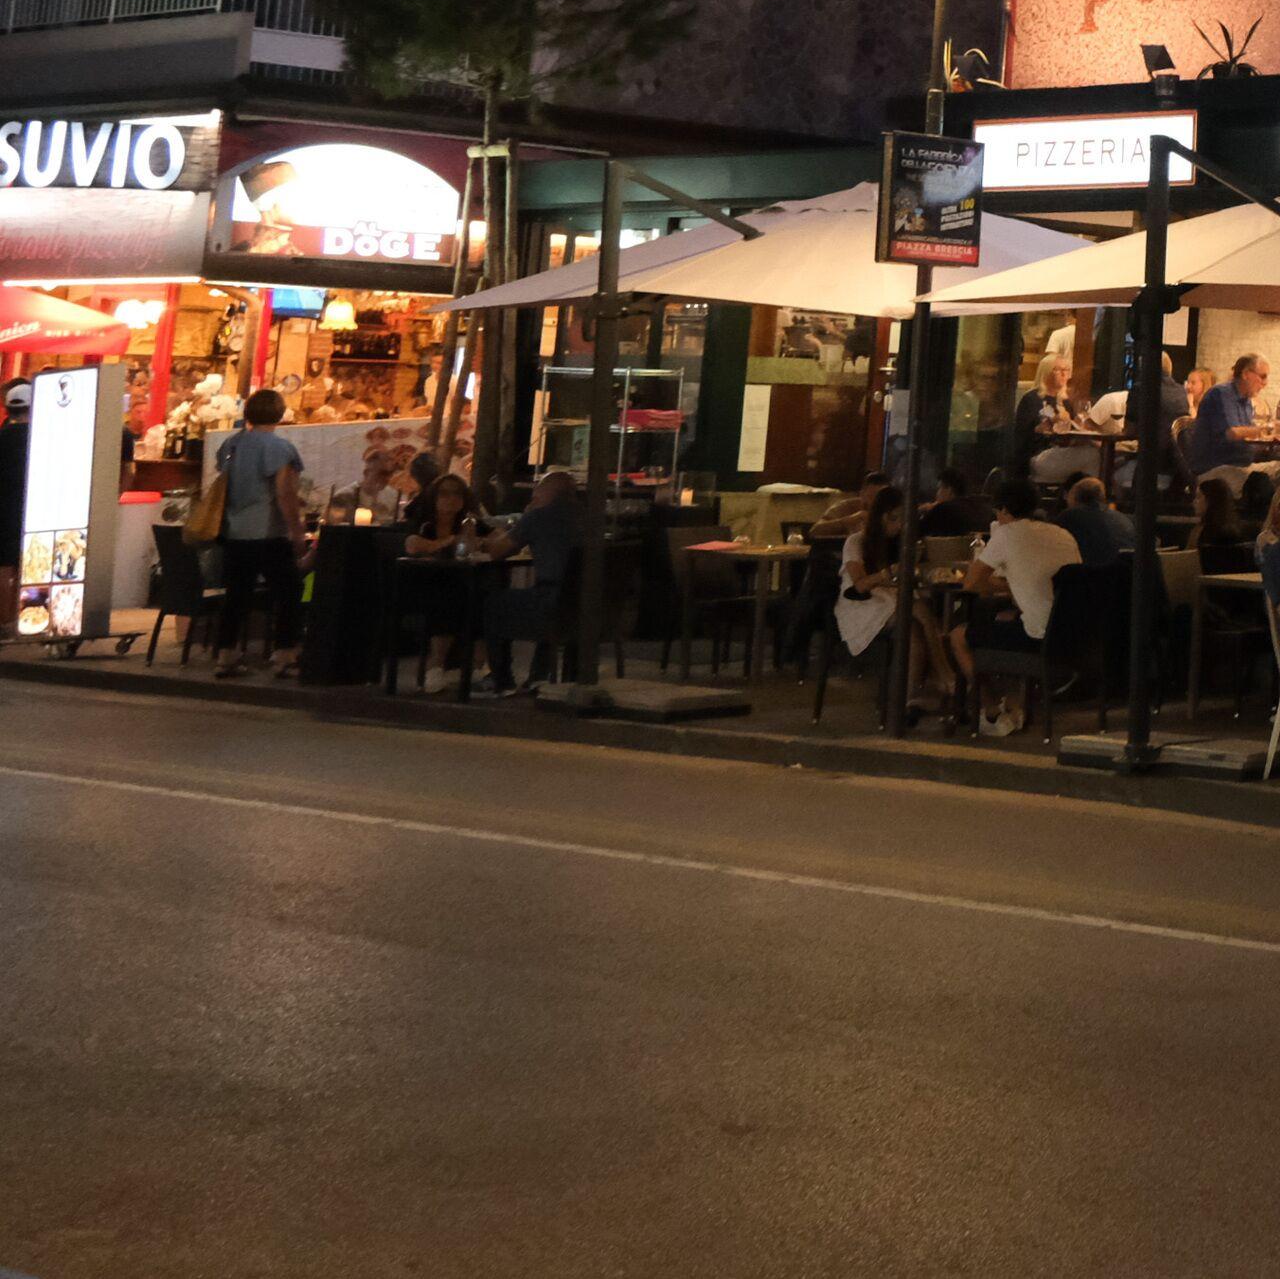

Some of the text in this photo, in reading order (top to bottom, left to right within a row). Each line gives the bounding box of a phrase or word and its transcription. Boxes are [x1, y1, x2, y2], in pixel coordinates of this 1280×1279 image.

[0, 121, 186, 189] SUVIO
[1016, 137, 1146, 167] PIZZERIA
[322, 226, 442, 261] DOGE
[353, 221, 382, 237] AL
[896, 241, 932, 253] PIAZZA
